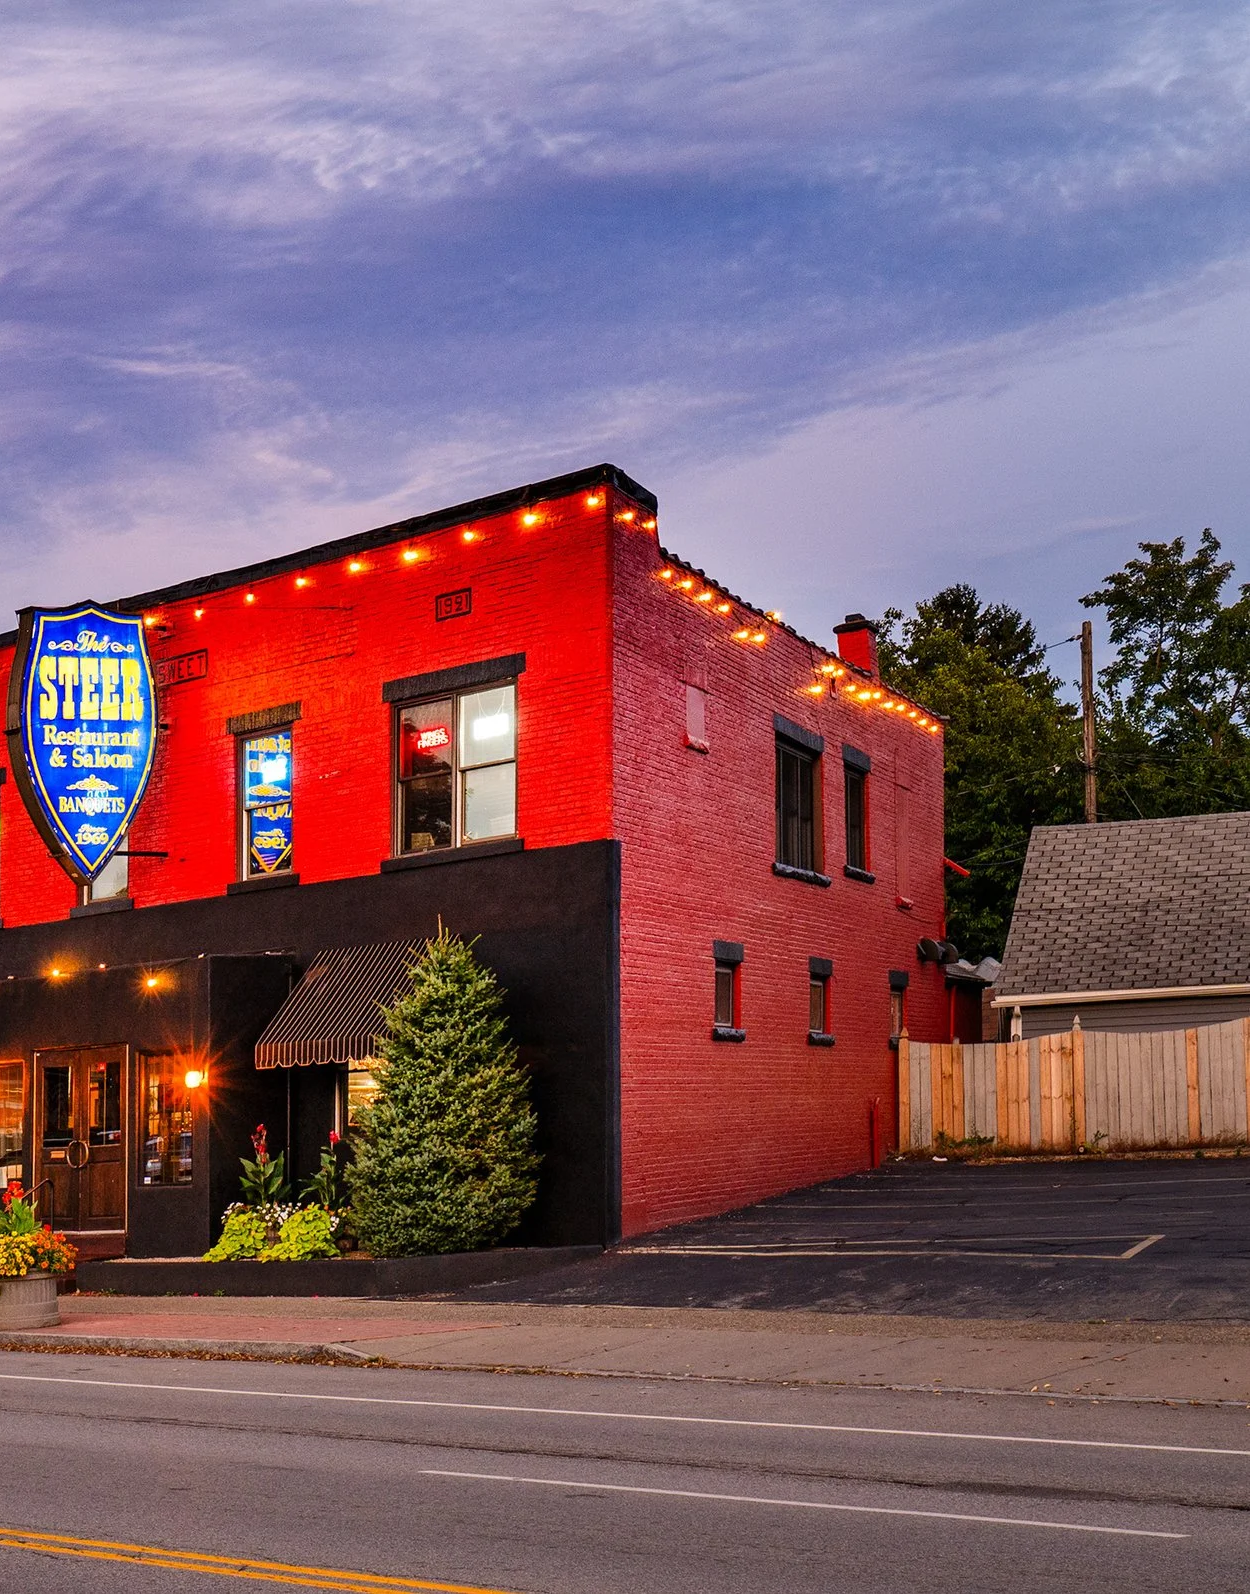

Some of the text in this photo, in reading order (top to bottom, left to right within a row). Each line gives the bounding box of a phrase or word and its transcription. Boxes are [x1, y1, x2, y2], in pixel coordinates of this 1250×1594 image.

[439, 593, 468, 617] 1921
[73, 630, 110, 653] The
[157, 655, 204, 683] SWEET
[39, 655, 144, 721] STEER
[43, 724, 140, 746] Restaurant
[49, 747, 134, 768] & Saloon
[58, 796, 126, 816] BANQUETS
[75, 833, 109, 845] 1969
